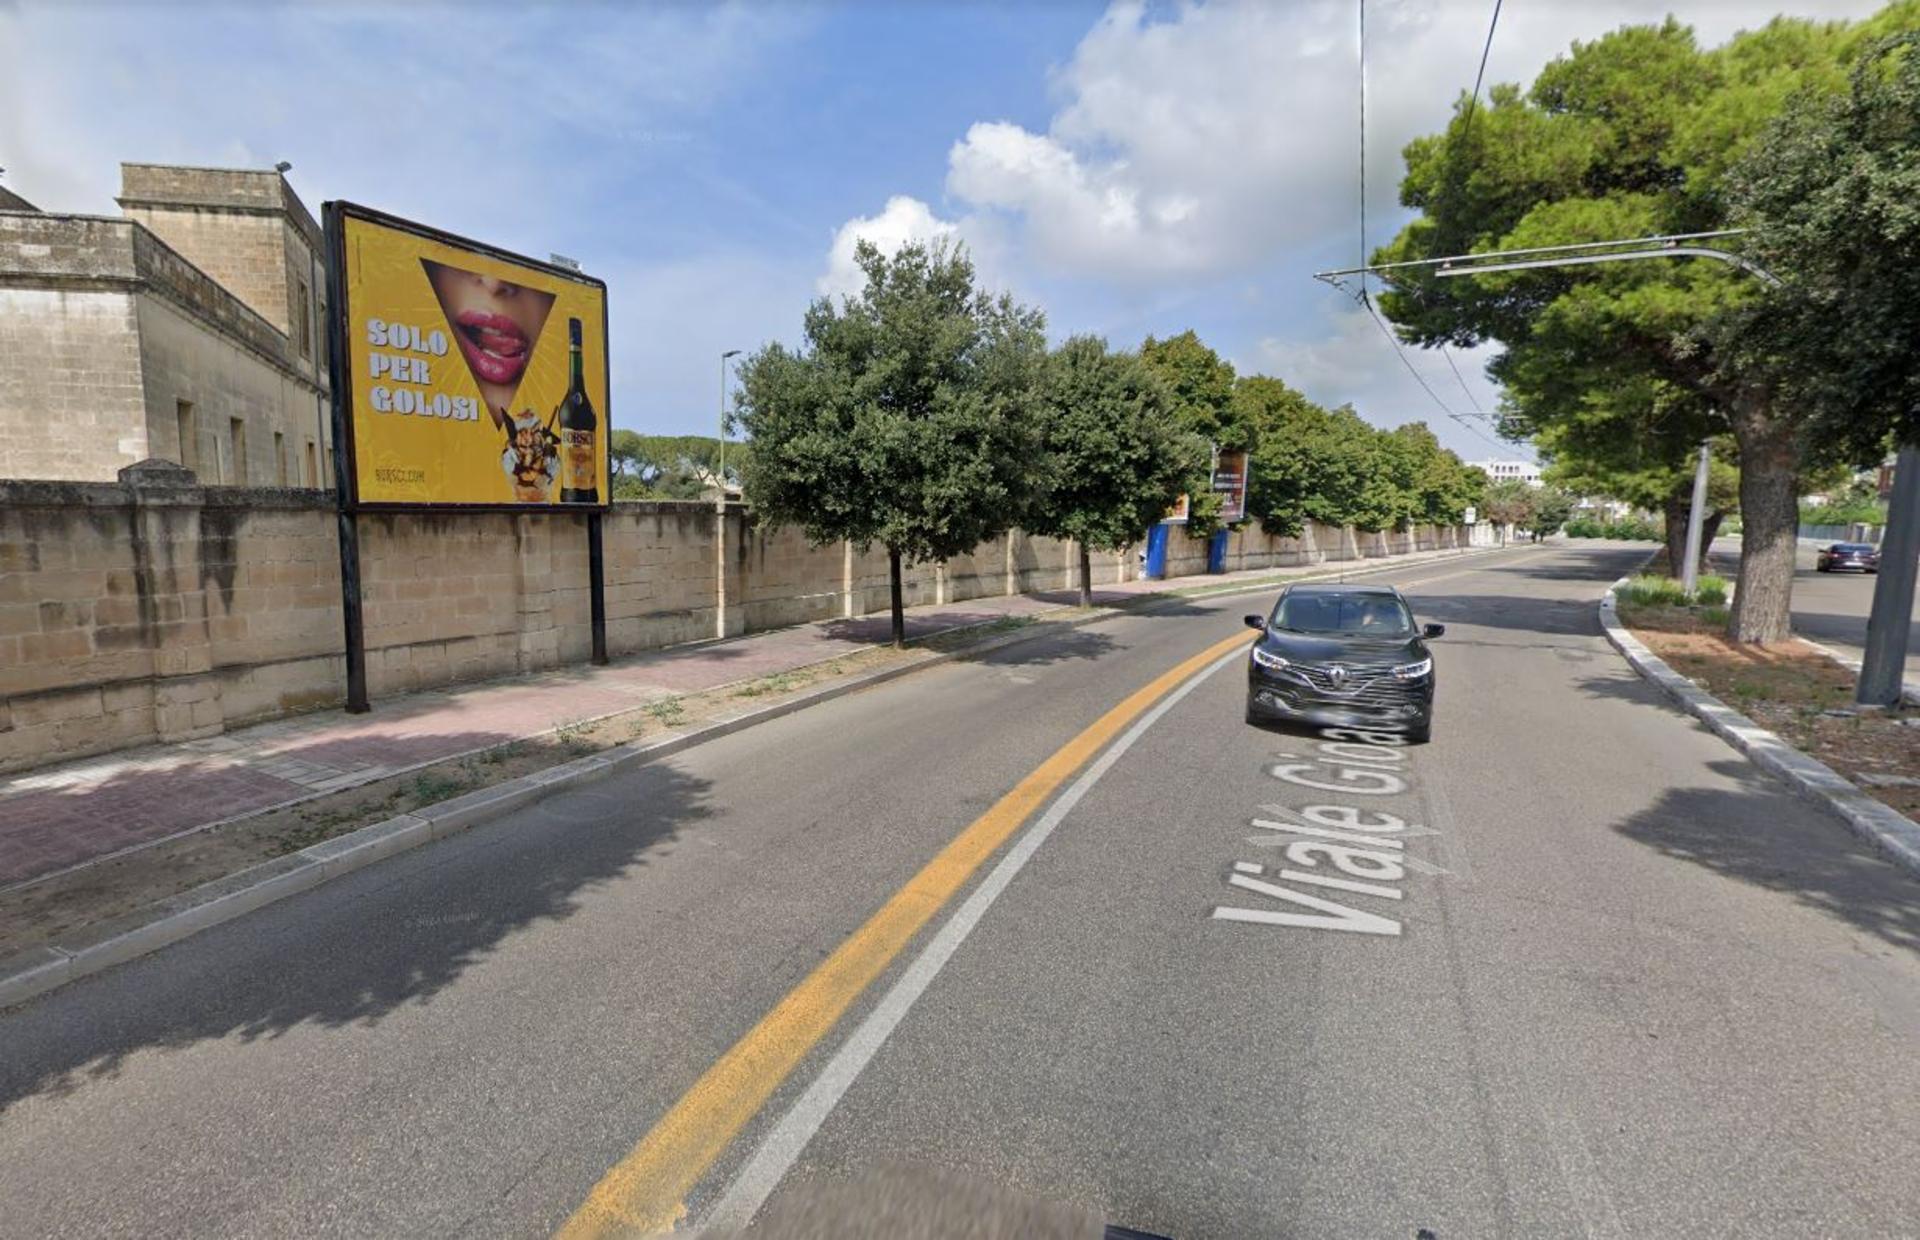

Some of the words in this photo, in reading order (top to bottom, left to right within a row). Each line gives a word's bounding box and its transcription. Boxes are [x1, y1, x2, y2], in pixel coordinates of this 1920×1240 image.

[367, 319, 449, 356] SOLO
[369, 353, 432, 384] PER
[369, 387, 480, 421] GOLOSI
